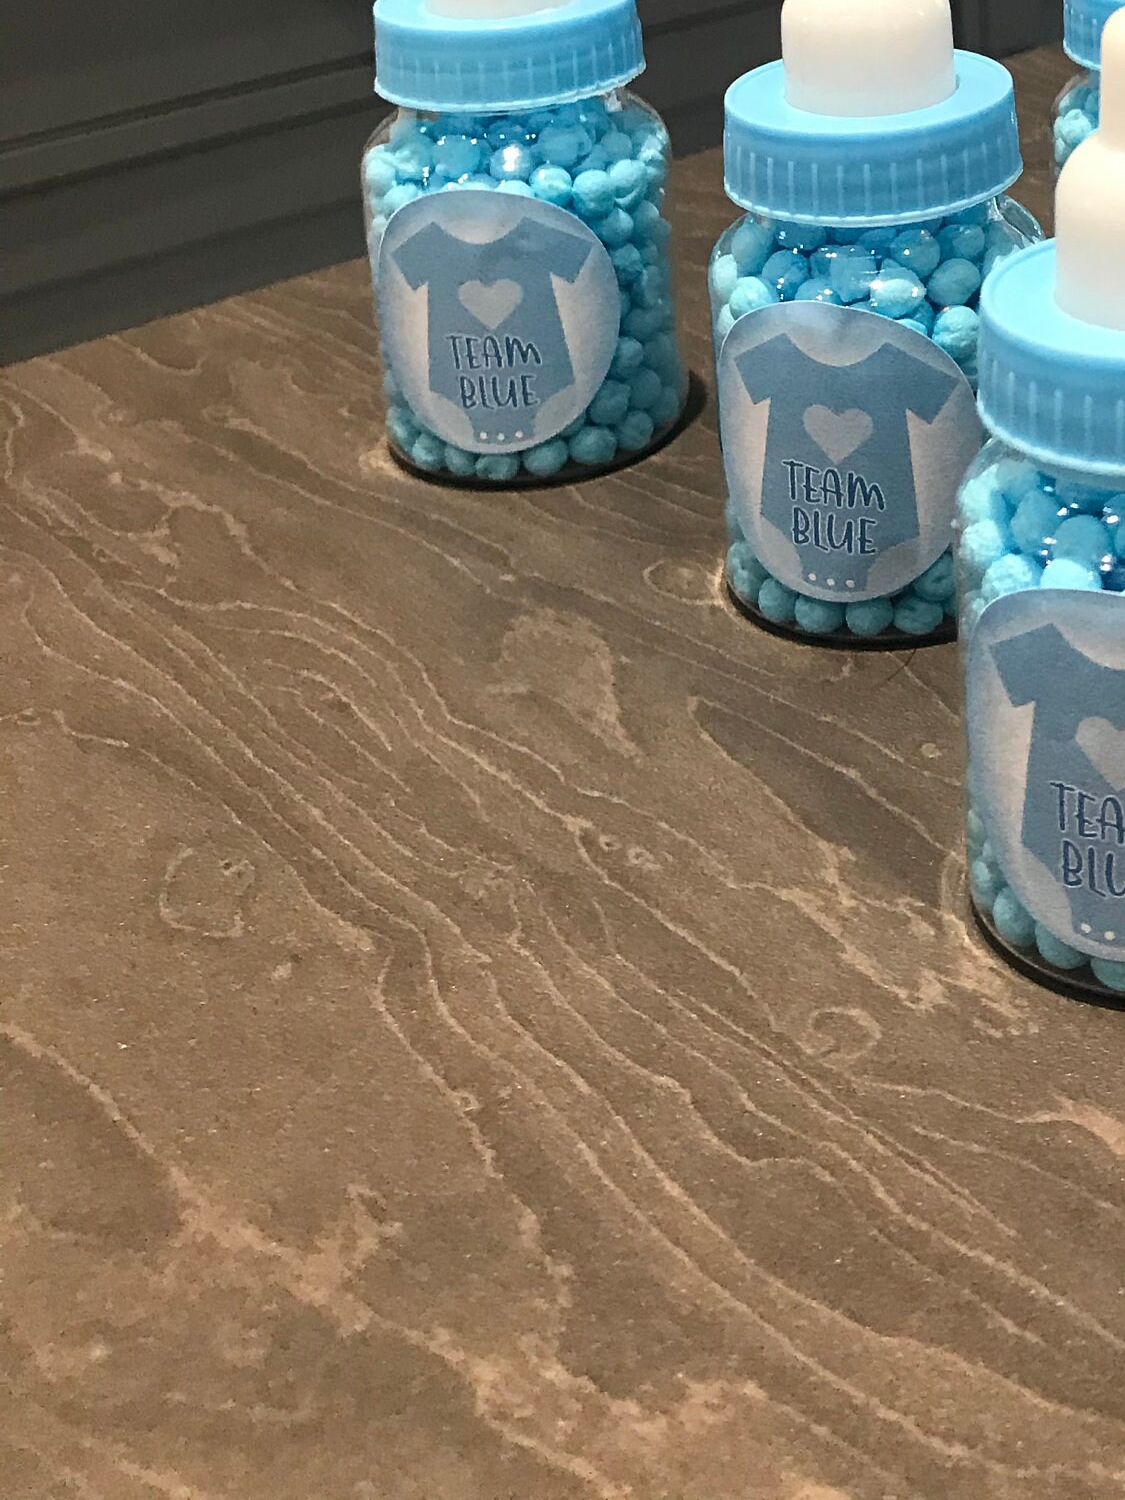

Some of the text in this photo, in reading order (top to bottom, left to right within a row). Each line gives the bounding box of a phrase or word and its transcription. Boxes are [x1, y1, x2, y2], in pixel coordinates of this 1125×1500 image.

[445, 334, 541, 369] TEAM
[459, 375, 538, 409] BLUE
[782, 460, 885, 510] TEAM
[792, 507, 877, 554] BLUE
